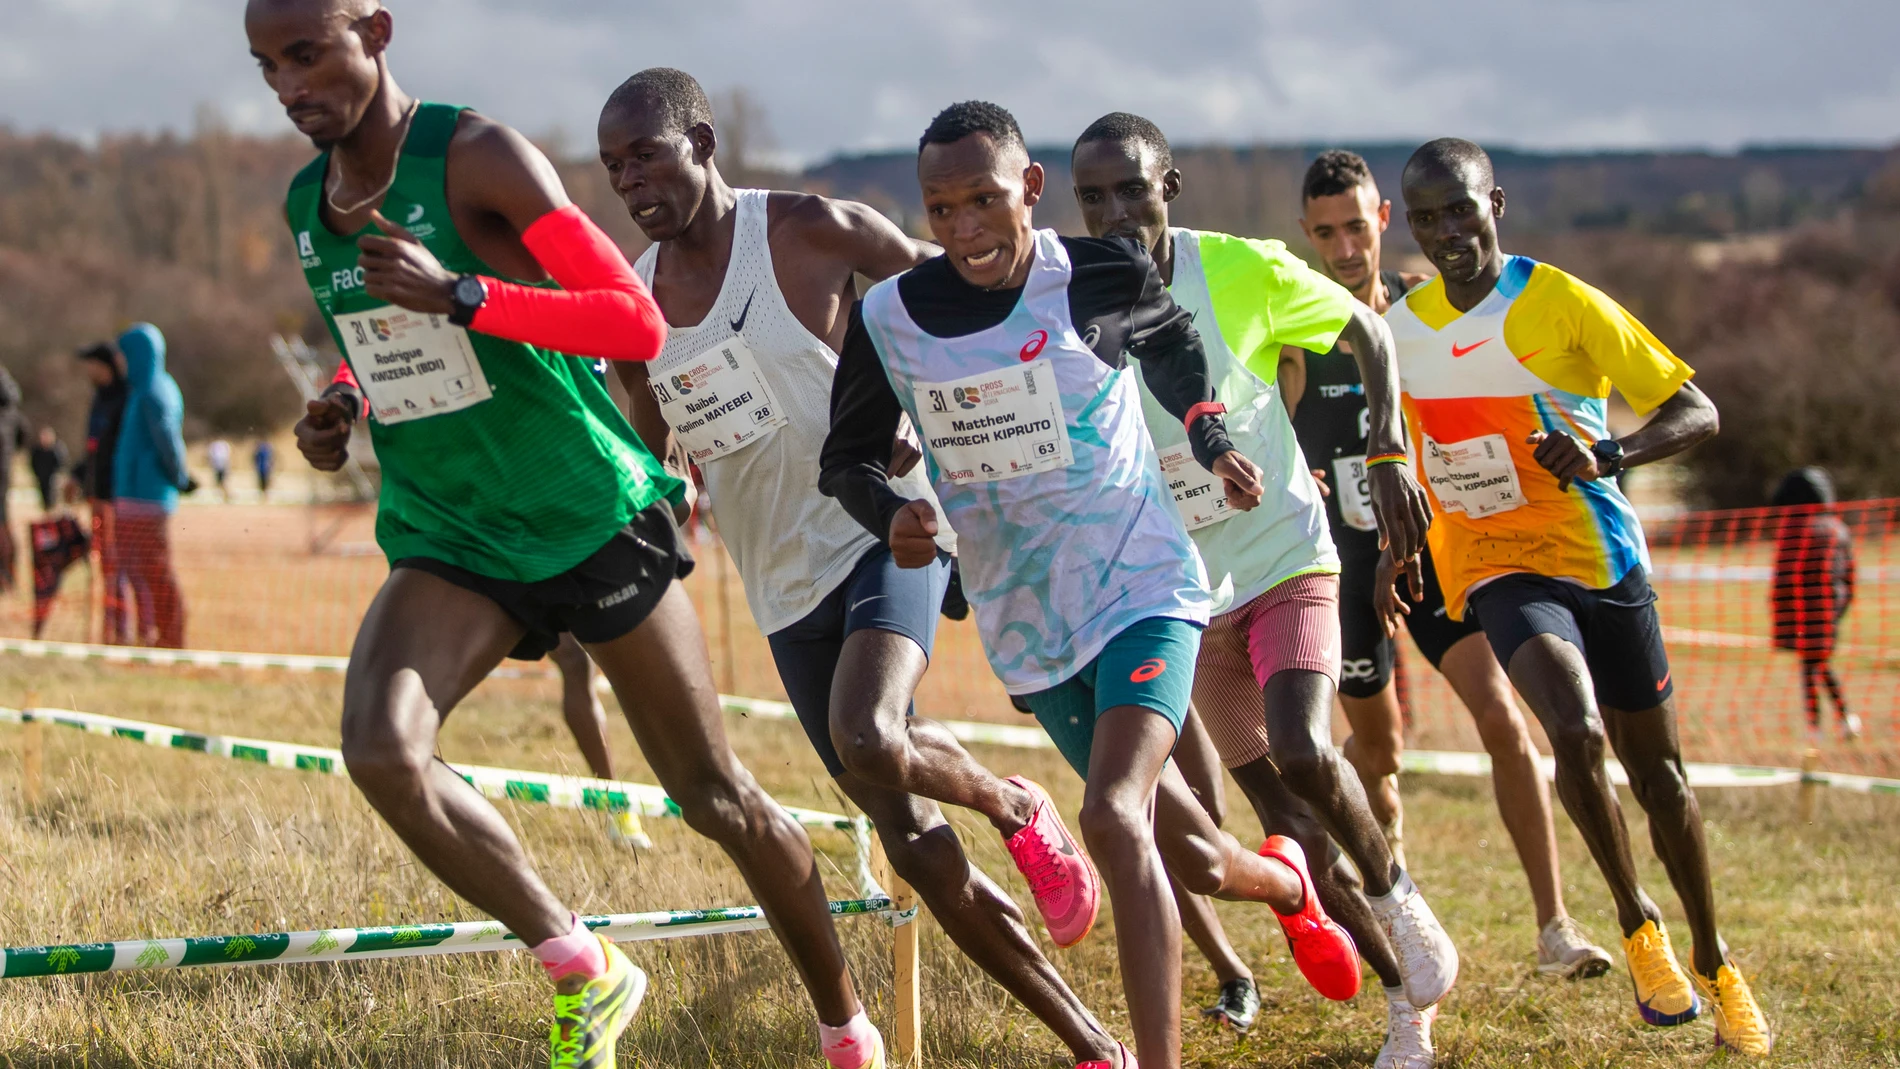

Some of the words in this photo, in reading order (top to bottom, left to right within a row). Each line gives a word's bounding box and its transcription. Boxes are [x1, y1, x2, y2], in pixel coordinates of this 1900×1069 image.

[351, 320, 369, 344] 31
[374, 348, 424, 366] Rodrigue
[370, 366, 415, 383] KWIZERA
[416, 359, 446, 375] (BDI)
[688, 364, 708, 378] CROSS
[456, 380, 464, 390] 1
[654, 382, 672, 404] 31
[980, 380, 1004, 392] CROSS
[982, 384, 1021, 398] INTERNACIONAL
[685, 392, 719, 414] Naibei
[929, 390, 948, 411] 31
[676, 418, 705, 434] Kiplimo
[704, 391, 753, 422] MAYEBEI
[754, 407, 770, 420] 28
[952, 412, 1016, 432] Matthew
[930, 433, 990, 449] KIPKOECH
[994, 419, 1051, 442] KIPRUTO
[1038, 443, 1056, 456] 63
[1163, 452, 1183, 462] CROSS
[1428, 441, 1440, 457] 3
[1350, 462, 1363, 478] 31
[1184, 484, 1211, 498] BETT
[1464, 475, 1510, 492] KIPSANG
